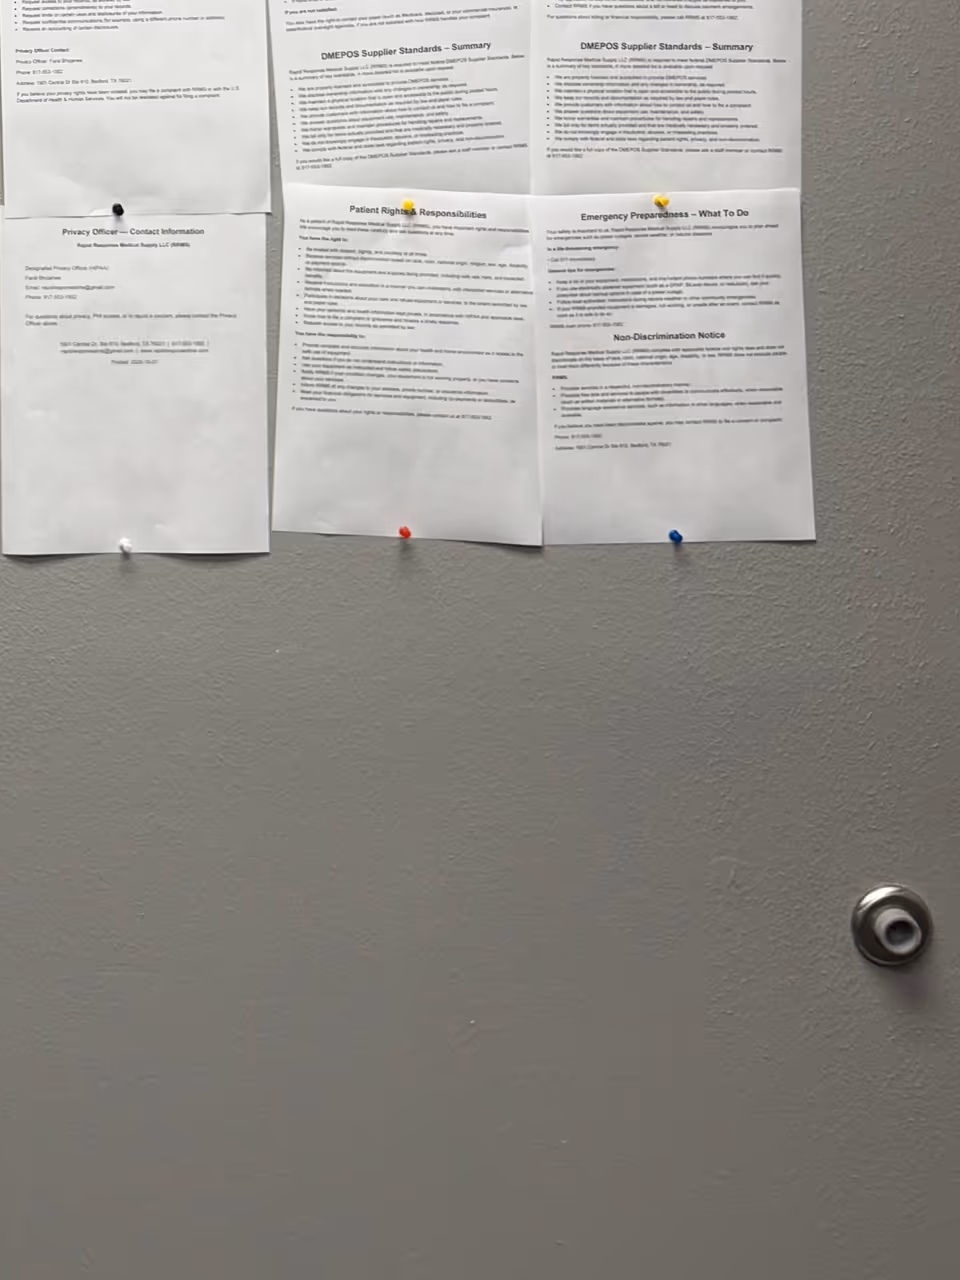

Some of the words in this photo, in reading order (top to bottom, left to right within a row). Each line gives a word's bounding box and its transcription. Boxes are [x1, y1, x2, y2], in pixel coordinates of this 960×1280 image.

[321, 50, 359, 60] DMEPOS
[361, 47, 396, 58] Supplier
[398, 44, 442, 54] Standards
[451, 41, 491, 51] Summary
[580, 42, 619, 50] DMEPOS
[620, 42, 656, 51] Supplier
[658, 42, 702, 50] Standards
[712, 42, 753, 52] Summary
[580, 212, 628, 223] Emergency
[630, 210, 689, 220] Preparedness
[698, 209, 721, 218] What
[723, 209, 735, 217] To
[736, 208, 749, 217] Do
[61, 228, 90, 236] Privacy
[160, 227, 204, 235] Information
[613, 331, 696, 341] Non-Discrimination
[697, 331, 725, 339] Notice
